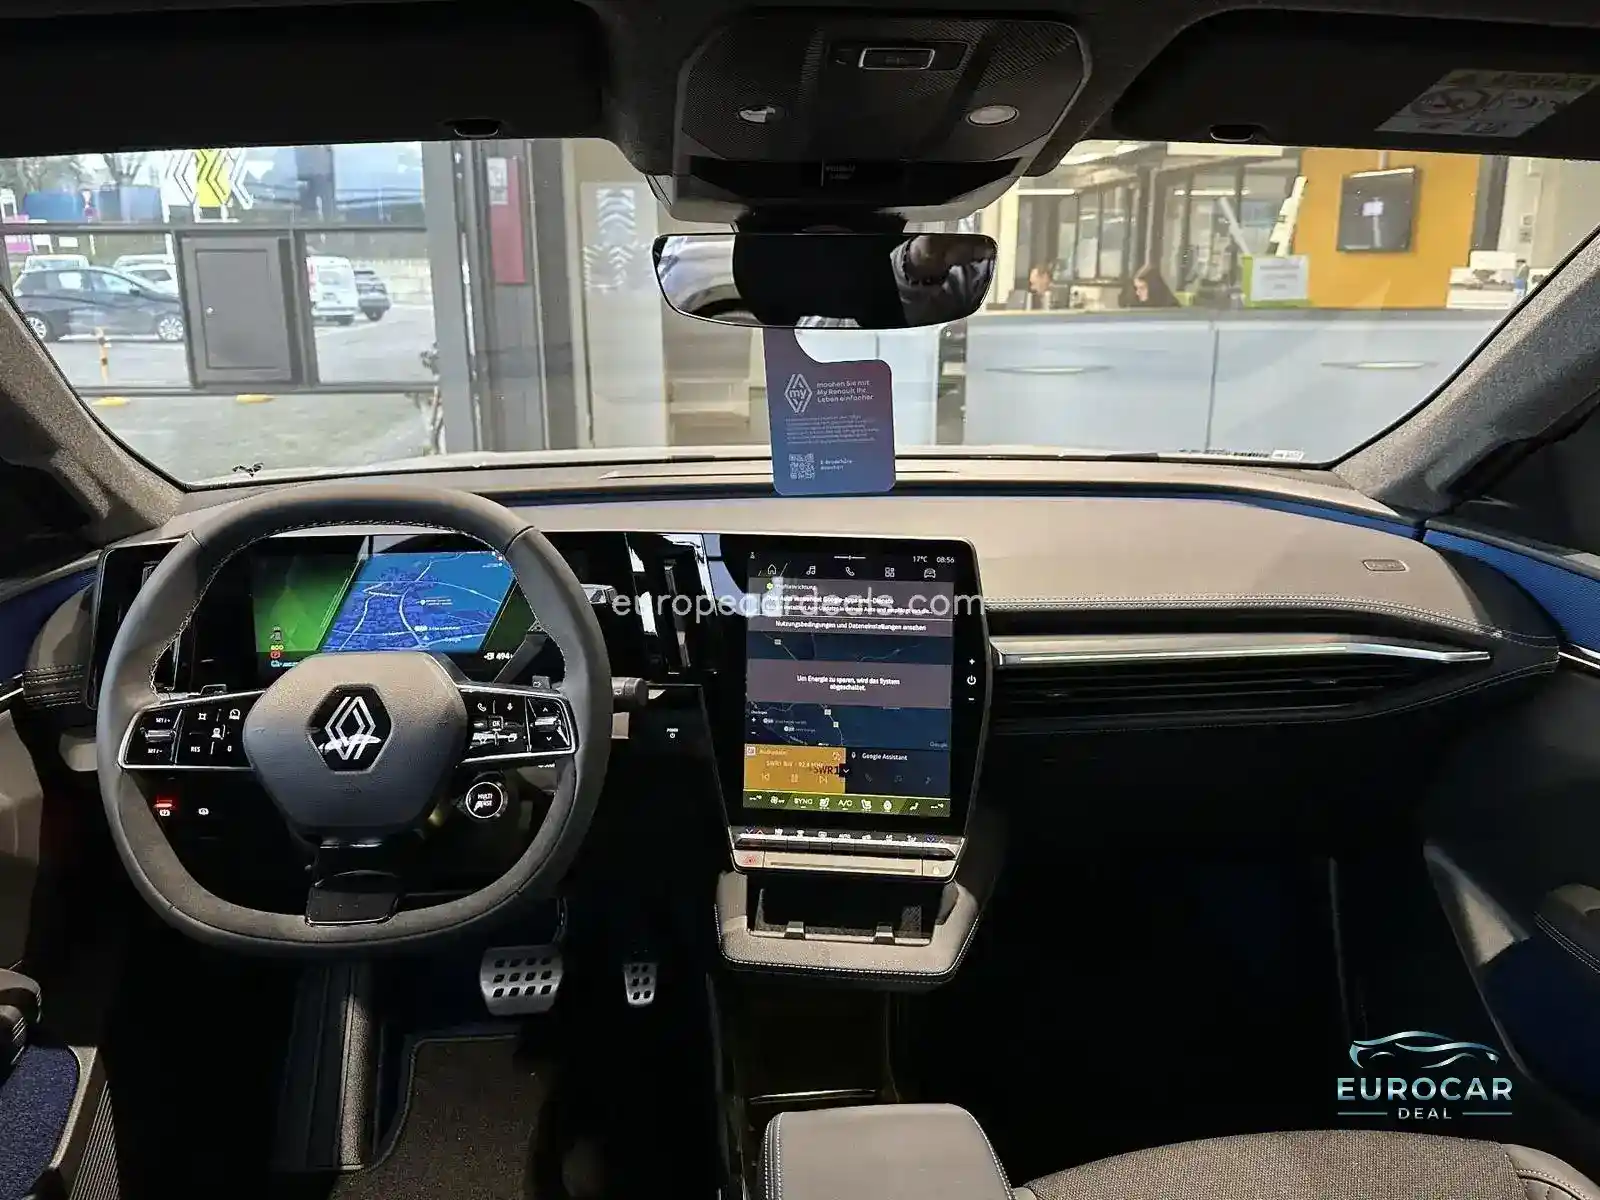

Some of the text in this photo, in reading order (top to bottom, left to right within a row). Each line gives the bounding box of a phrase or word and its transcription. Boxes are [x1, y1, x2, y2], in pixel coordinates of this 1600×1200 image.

[789, 390, 806, 401] my
[808, 675, 828, 683] Energie
[861, 752, 908, 761] Google Assistant
[793, 797, 813, 805] SYNC
